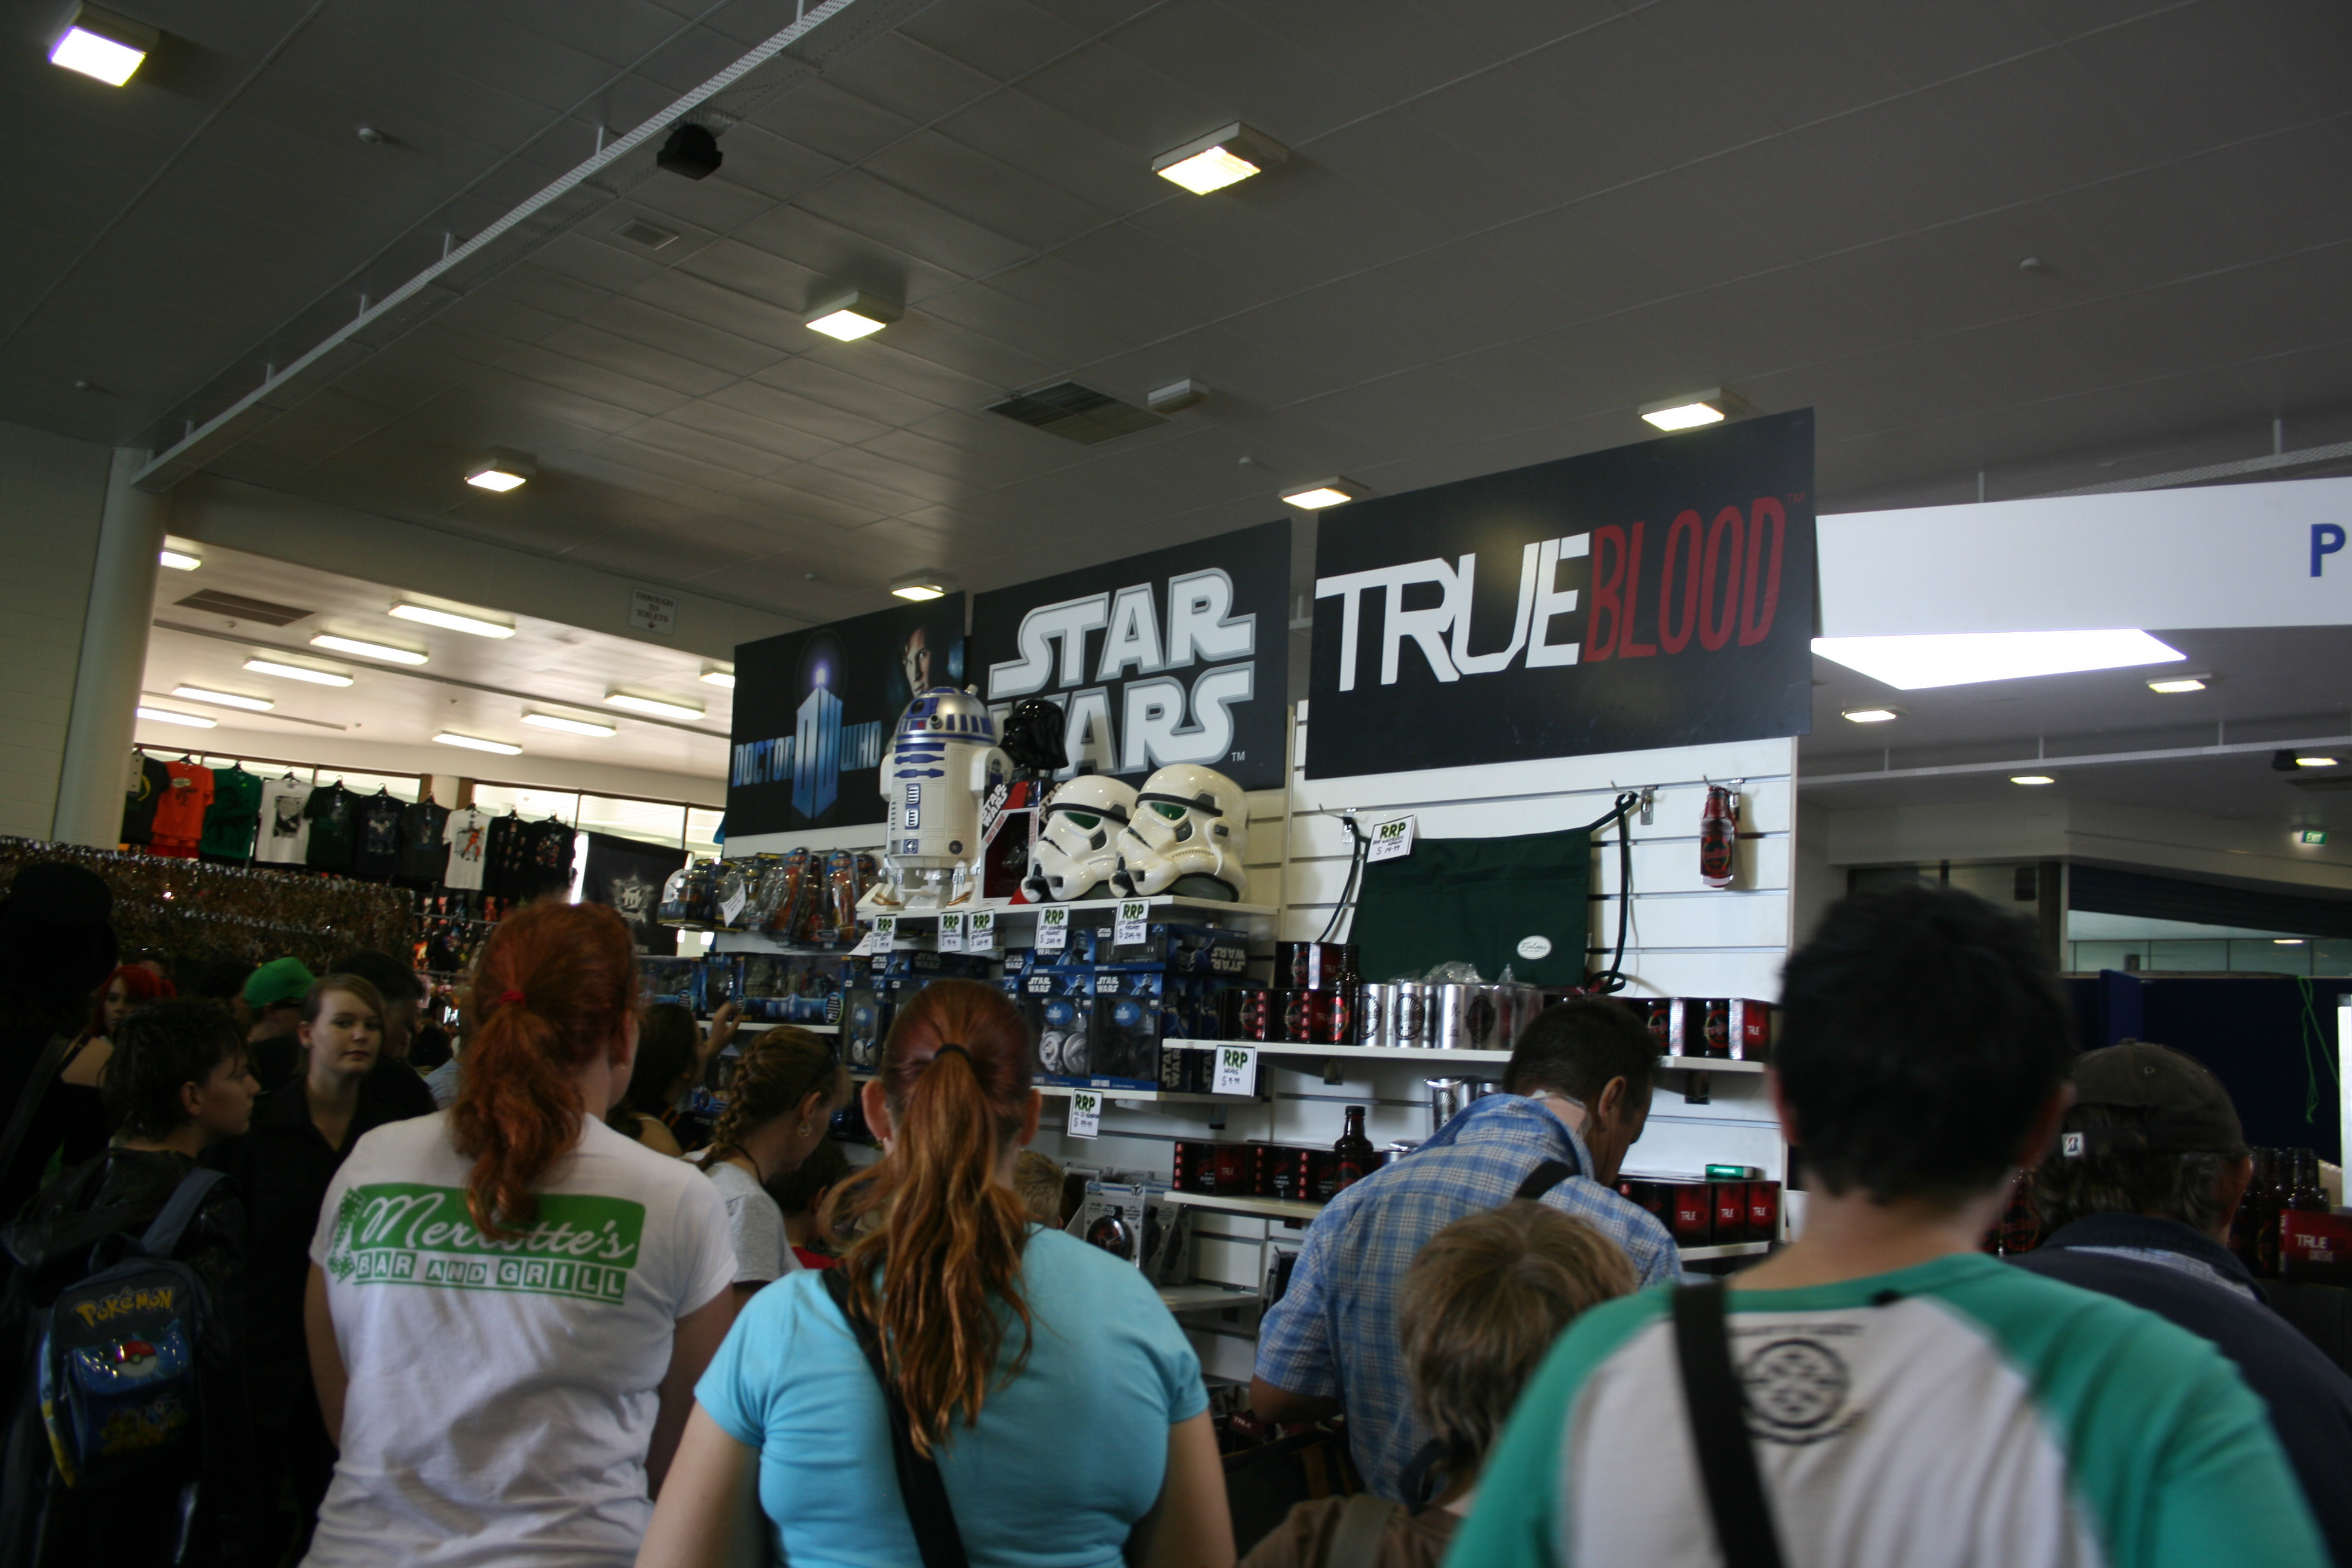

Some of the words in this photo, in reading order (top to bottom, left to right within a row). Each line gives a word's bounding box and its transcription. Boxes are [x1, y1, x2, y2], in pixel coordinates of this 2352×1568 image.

[2310, 523, 2346, 577] P
[635, 592, 674, 607] THROUGH
[1315, 532, 1590, 691] TRUE
[1584, 496, 1786, 662] BLOOD
[648, 604, 659, 612] TO
[636, 609, 668, 622] TOILETS
[988, 567, 1256, 700] STAR
[732, 735, 795, 788] DOCTOR
[840, 720, 882, 773] WHO
[1232, 751, 1245, 762] TM
[1380, 822, 1406, 839] RRP
[1044, 909, 1064, 924] RRP
[1123, 904, 1144, 919] RRP
[877, 918, 892, 932] RRP
[942, 915, 959, 929] RRP
[973, 914, 990, 929] RRP
[1212, 947, 1246, 959] WARS
[1211, 958, 1246, 972] STAR
[1028, 976, 1051, 985] STAR
[1096, 976, 1119, 985] STAR
[1027, 984, 1051, 993] WARS
[1096, 984, 1119, 993] WARS
[1224, 1049, 1247, 1070] RRP
[1075, 1094, 1095, 1112] RRP
[1680, 1211, 1696, 1221] TRUE
[1720, 1208, 1734, 1218] TRUE
[1752, 1206, 1766, 1216] TRUE
[2295, 1233, 2328, 1249] TRUE
[357, 1252, 414, 1278] BAR
[427, 1261, 486, 1282] AND
[498, 1259, 624, 1298] GRILL
